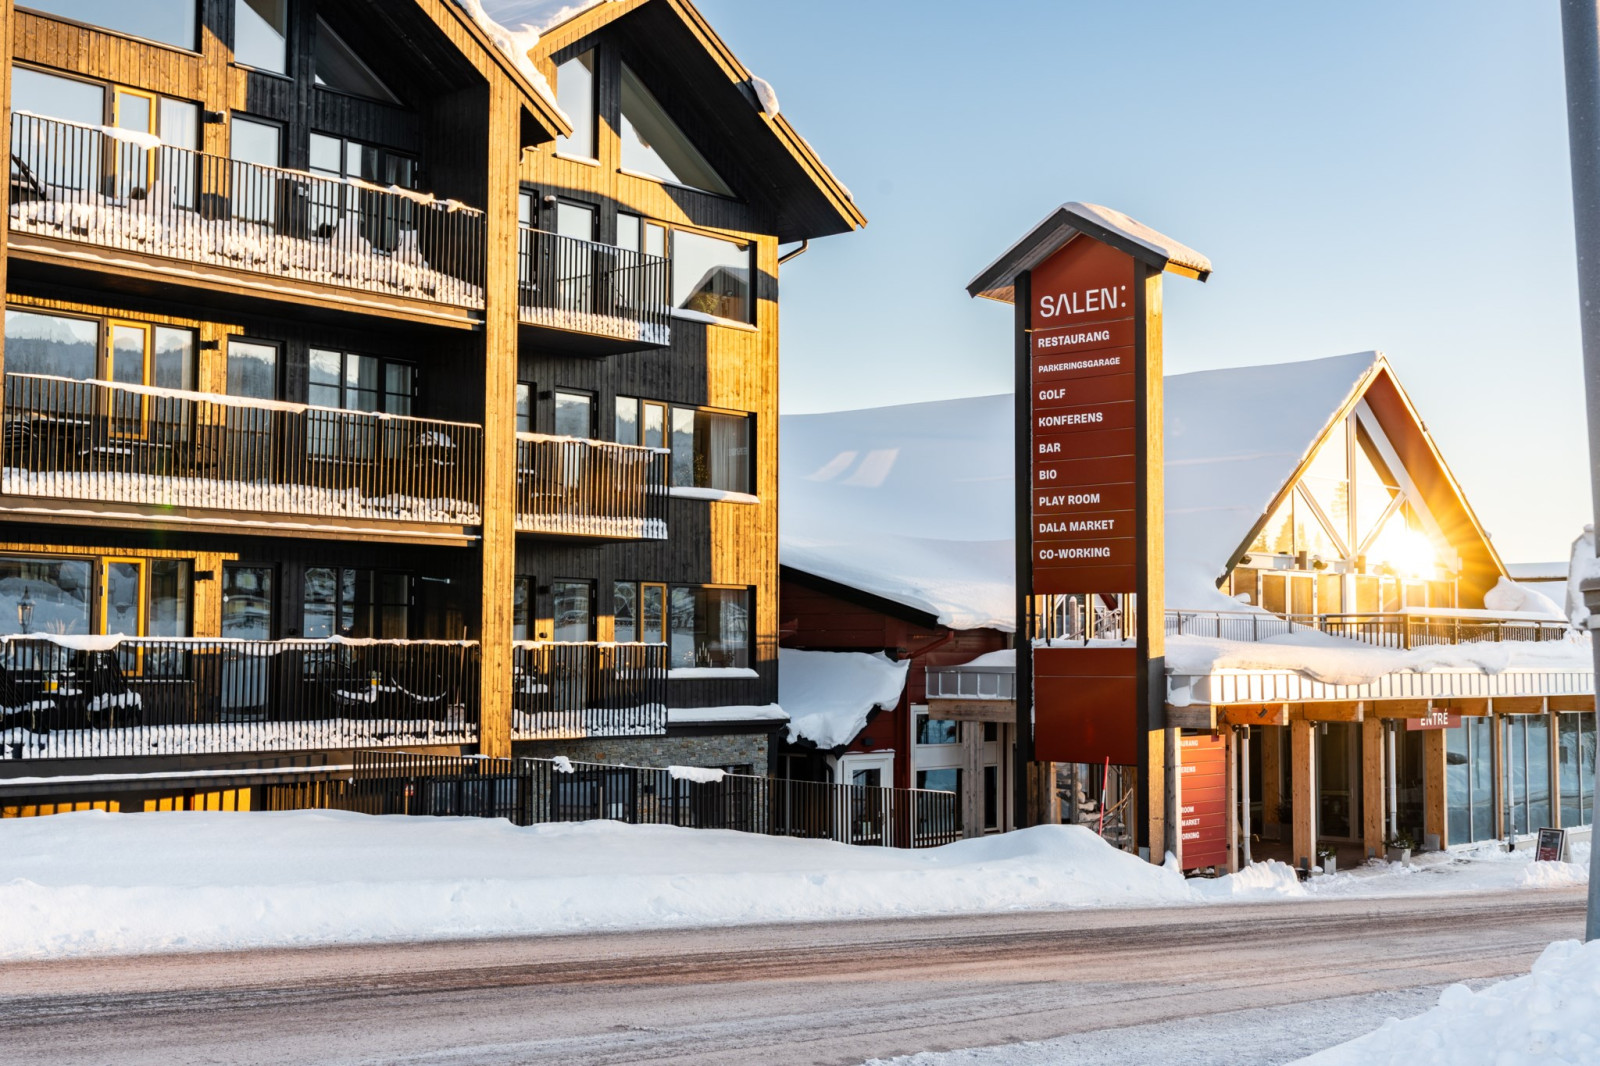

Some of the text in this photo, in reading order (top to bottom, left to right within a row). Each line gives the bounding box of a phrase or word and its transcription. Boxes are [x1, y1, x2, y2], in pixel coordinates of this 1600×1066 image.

[1038, 330, 1110, 348] RESTAURANG
[1038, 357, 1120, 373] PARKERINGSGARAGE
[1039, 389, 1066, 400] GOLF
[1038, 412, 1103, 427] KONFERENS
[1039, 443, 1061, 453] BAR
[1039, 469, 1057, 480] BIO
[1039, 493, 1100, 506] PLAY ROOM
[1039, 519, 1114, 533] DALA MARKET
[1039, 547, 1110, 559] CO-WORKING
[1420, 708, 1449, 726] ENTRÉ
